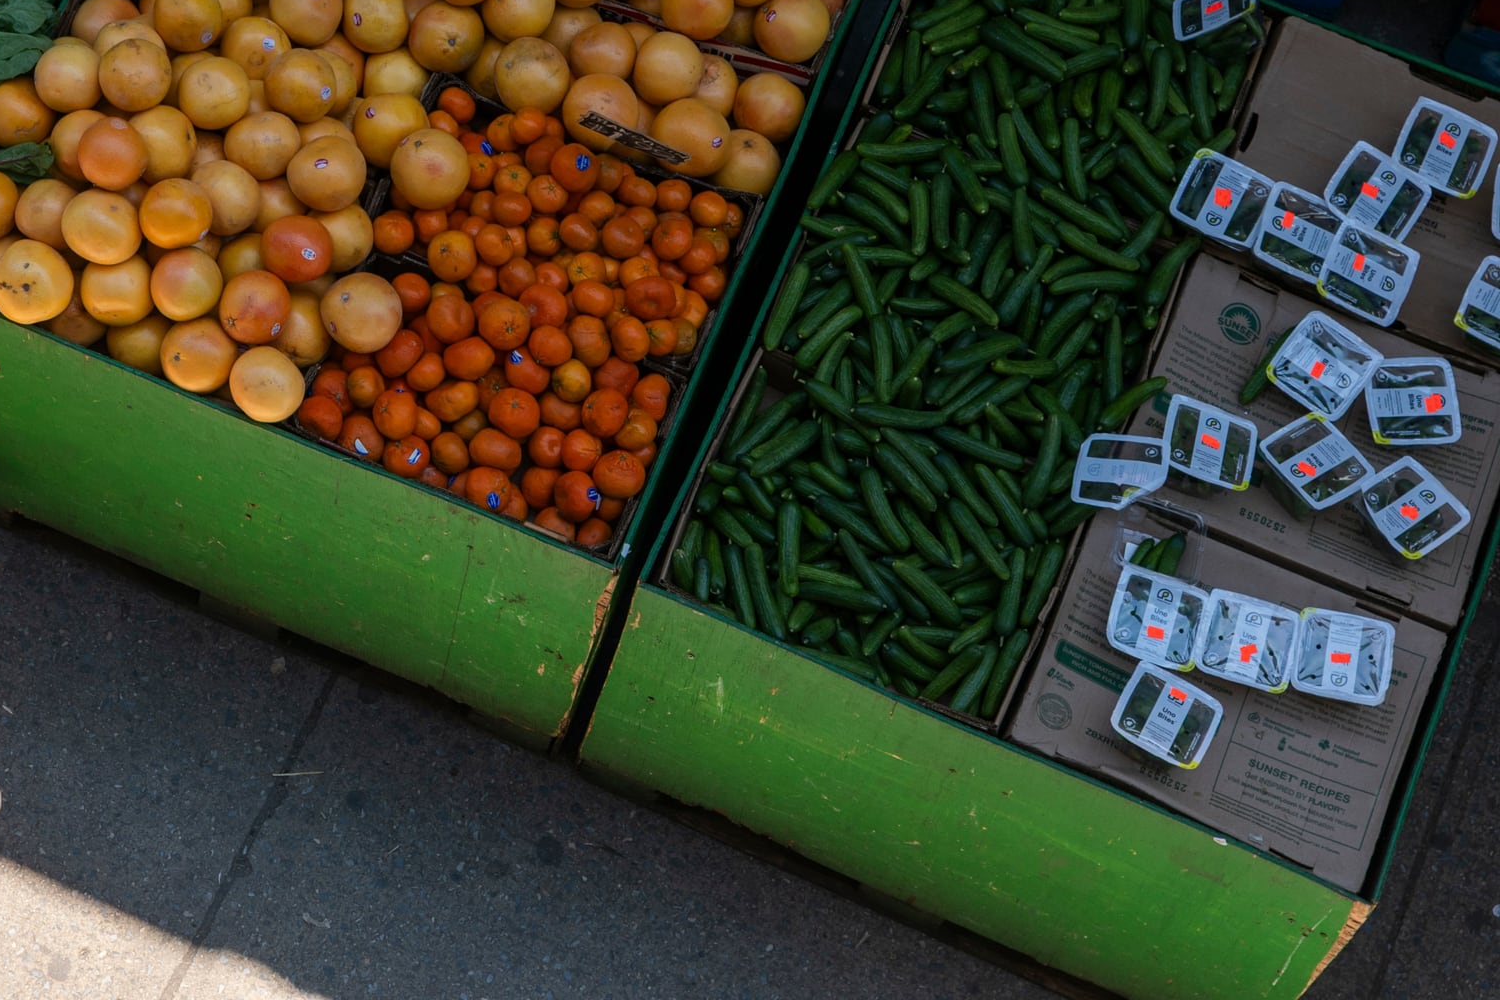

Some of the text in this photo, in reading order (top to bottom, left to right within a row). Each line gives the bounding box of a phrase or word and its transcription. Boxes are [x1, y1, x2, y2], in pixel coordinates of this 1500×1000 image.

[1217, 316, 1260, 344] SUNSET
[1239, 506, 1287, 534] 2520558
[1150, 614, 1168, 626] Bites
[1154, 607, 1168, 618] Uno
[1157, 713, 1175, 726] Bites
[1162, 706, 1177, 718] Uno
[1245, 771, 1258, 783] Get
[1258, 774, 1296, 797] INSPIRED
[1248, 758, 1350, 804] SUNSET RECIPES
